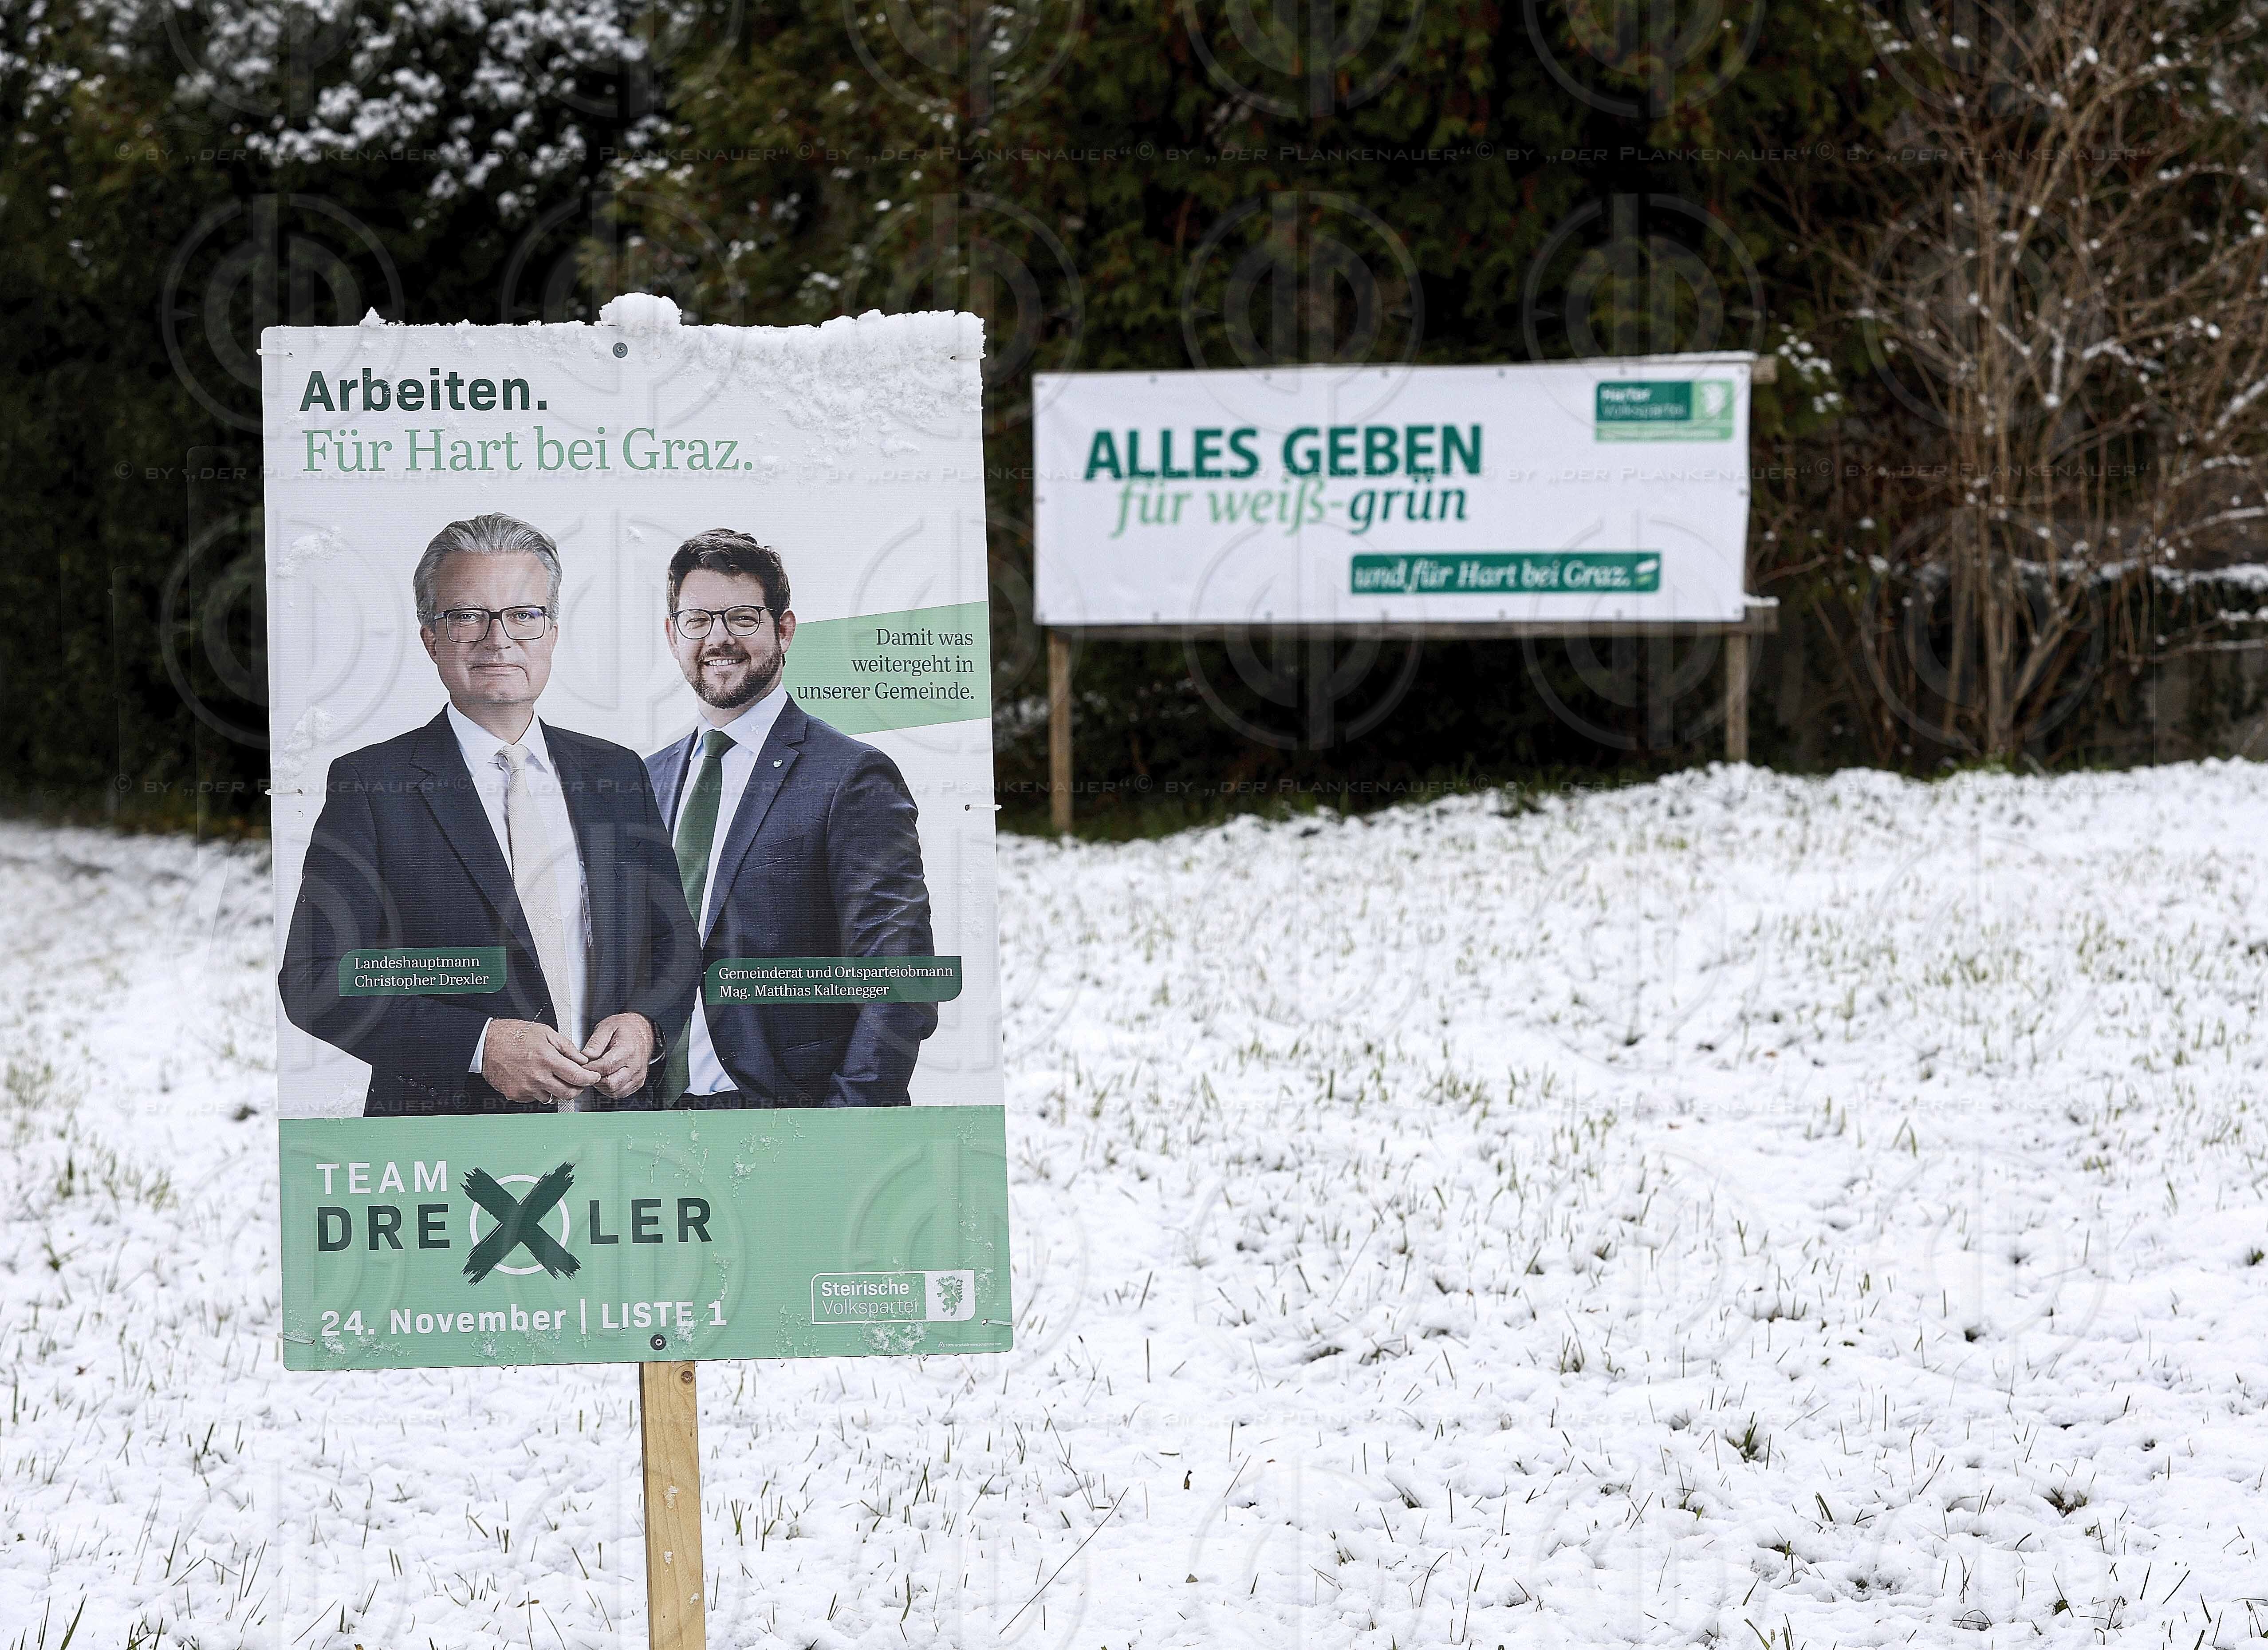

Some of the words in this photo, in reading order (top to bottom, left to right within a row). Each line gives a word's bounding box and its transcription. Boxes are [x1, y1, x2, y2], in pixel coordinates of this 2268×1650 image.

[299, 367, 548, 412] Arbeiten.
[302, 428, 392, 472] Für
[408, 427, 521, 472] Hart
[535, 425, 606, 471] bei
[622, 426, 753, 471] Graz.
[1085, 428, 1259, 481] ALLES
[1282, 424, 1481, 478] GEBEN
[1111, 481, 1189, 538] für
[1209, 474, 1468, 536] weiß-grün
[1355, 561, 1406, 588] und
[1405, 559, 1453, 593] für
[1457, 561, 1516, 588] Hart
[1521, 560, 1559, 587] bei
[1563, 561, 1630, 587] Graz.
[876, 628, 934, 646] Damit
[938, 632, 973, 646] was
[851, 655, 952, 677] weitergeht
[955, 655, 974, 673] in
[797, 686, 870, 699] unserer
[874, 682, 974, 699] Gemeinde.
[354, 956, 480, 971] Landeshauptmann
[719, 967, 803, 980] Gemeinderat
[806, 967, 832, 979] und
[835, 965, 953, 979] Ortsparteiobmann
[354, 974, 436, 989] Christopher
[439, 973, 489, 986] Drexler
[719, 985, 751, 1000] Mag.
[754, 984, 811, 997] Matthias
[814, 984, 889, 999] Kaltenegger
[316, 1160, 447, 1195] TEAM
[317, 1160, 713, 1287] DREXLER
[821, 1280, 910, 1297] Steirische
[321, 1309, 375, 1337] 24.
[390, 1304, 567, 1334] November
[602, 1301, 695, 1328] LISTE
[709, 1300, 727, 1326] 1
[822, 1299, 919, 1316] Volkspartei
